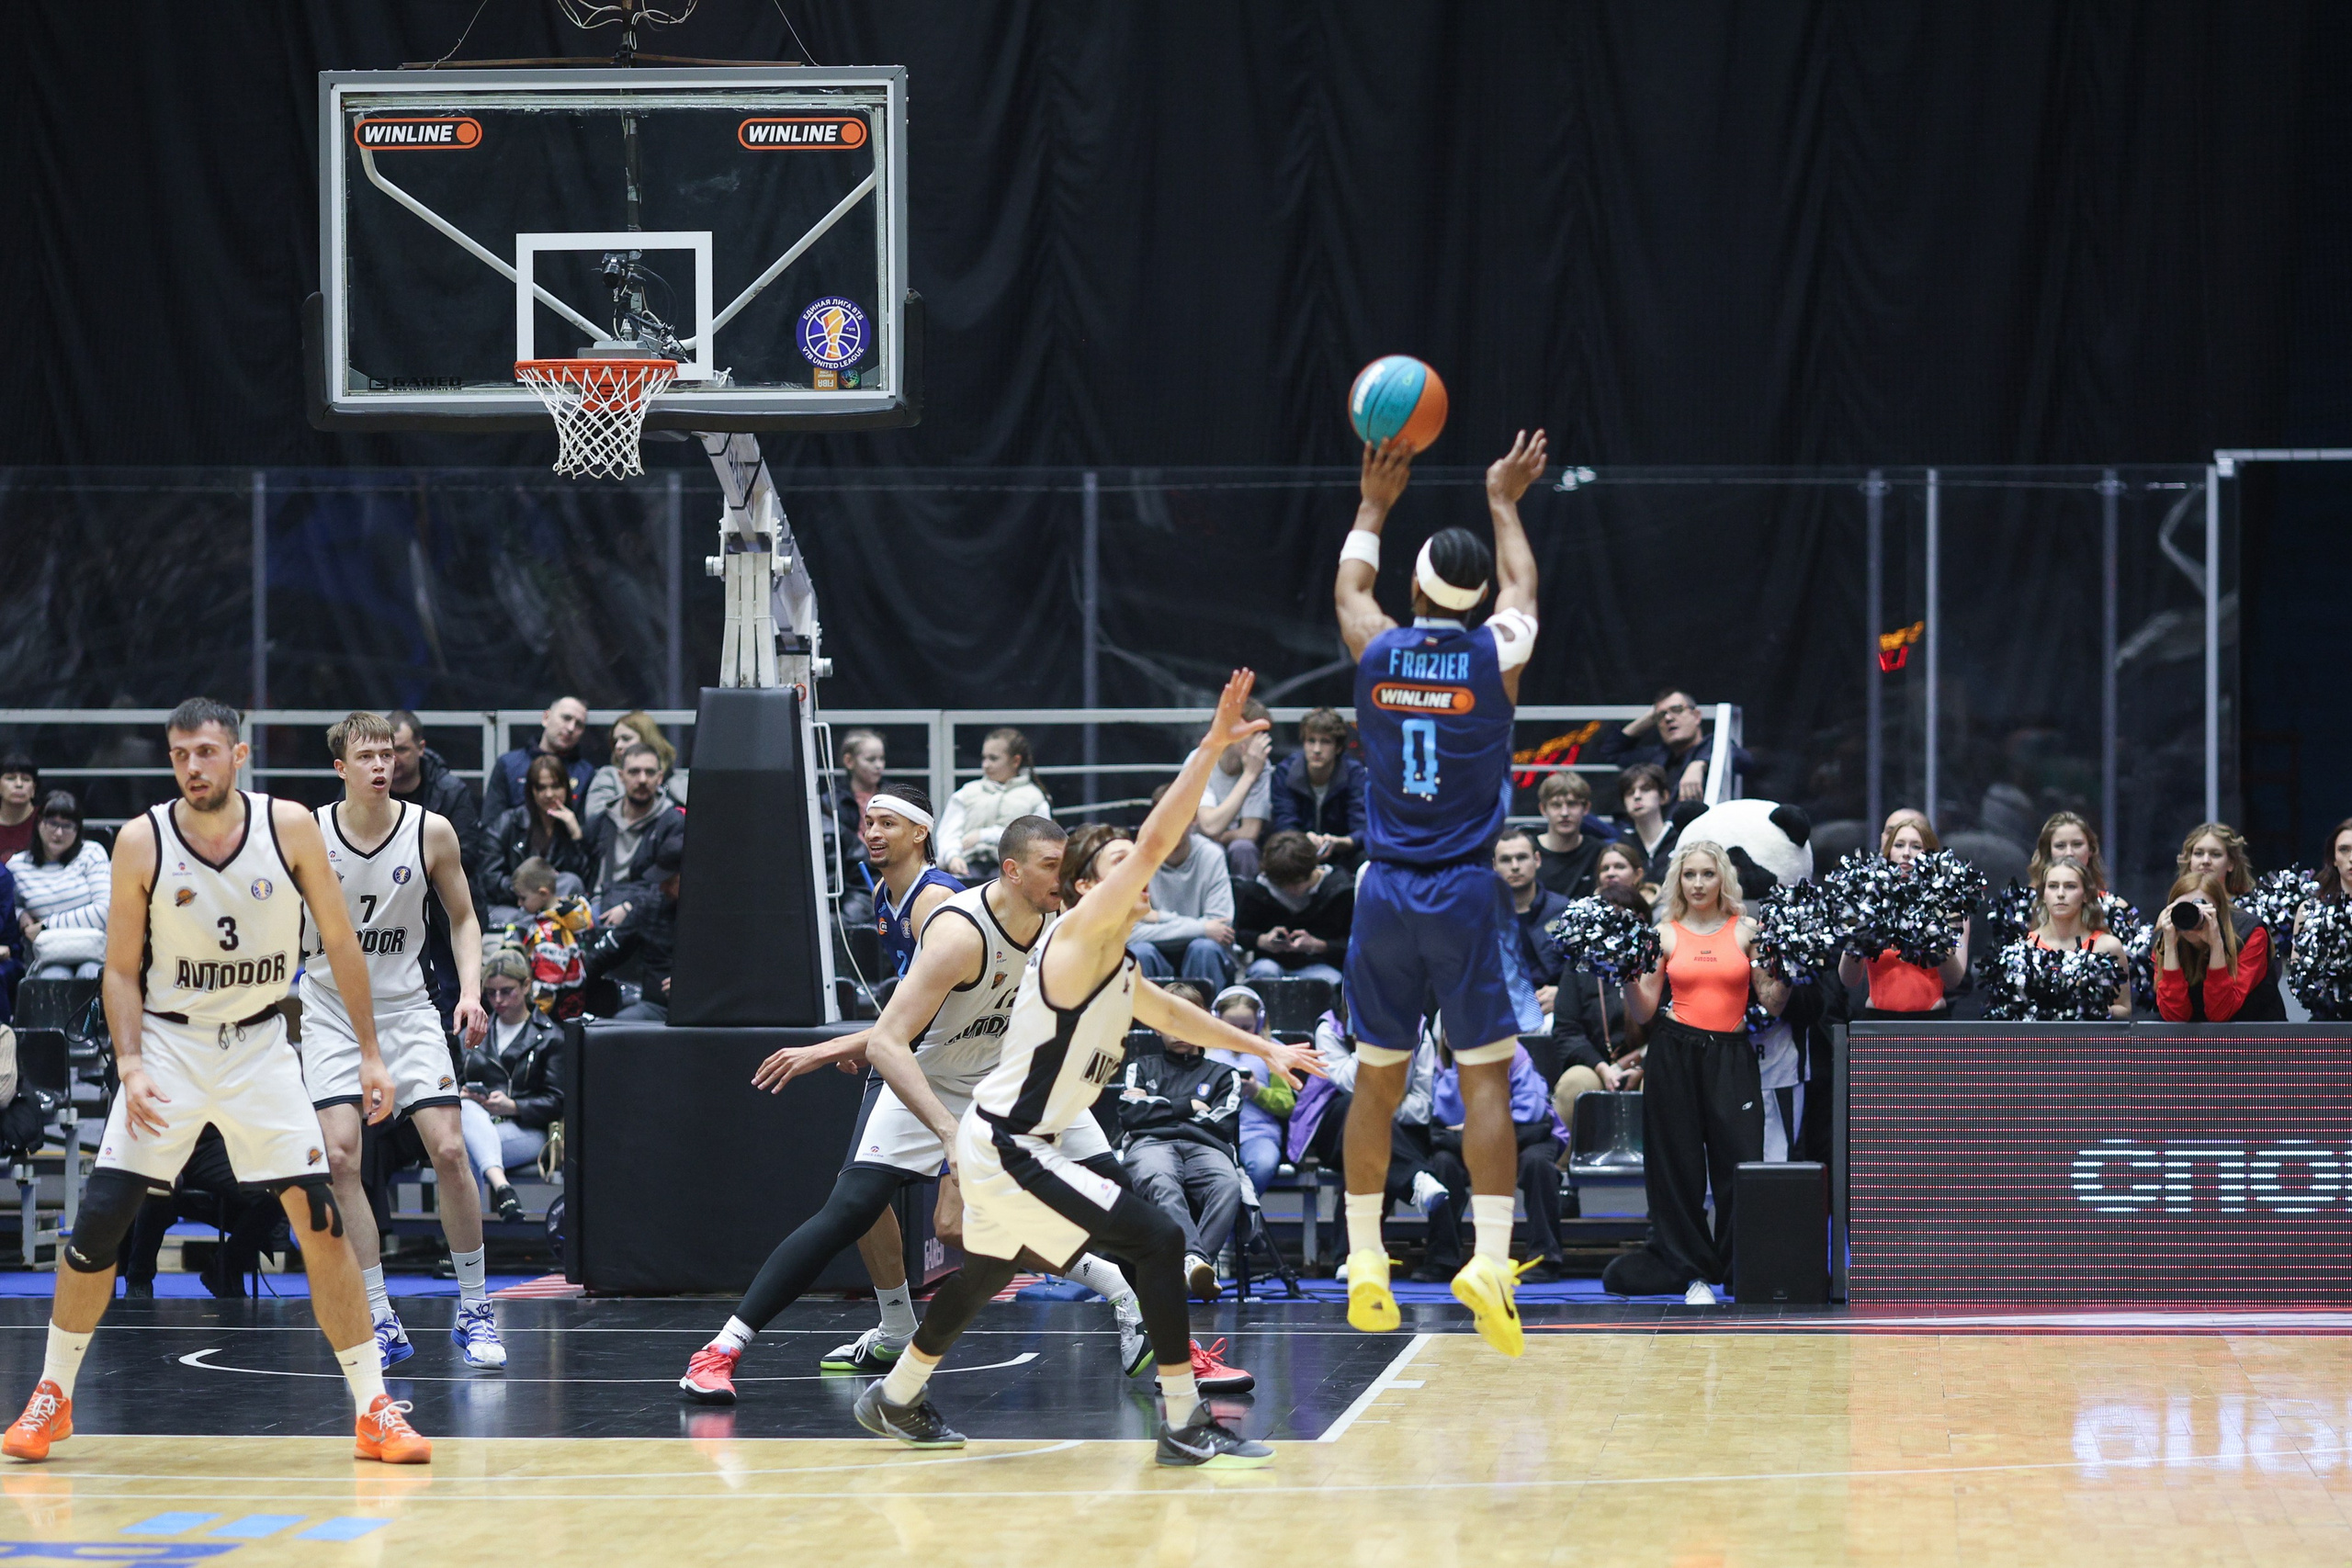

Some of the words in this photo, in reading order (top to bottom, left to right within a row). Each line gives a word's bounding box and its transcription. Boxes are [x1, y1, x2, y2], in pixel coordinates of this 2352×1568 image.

[364, 124, 454, 144] WINLINE
[747, 124, 839, 144] WINLINE
[802, 299, 831, 321] ЕДИНАЯ
[831, 299, 853, 310] ЛИГА
[851, 307, 865, 321] ВТБ
[802, 345, 812, 360] VTB
[812, 358, 839, 369] UNITED
[839, 346, 865, 368] LEAGUE
[392, 376, 462, 387] GARED
[818, 379, 834, 388] FIBA
[1388, 649, 1470, 680] FRAZIER
[1380, 688, 1453, 709] WINLINE
[1401, 718, 1439, 795] 0
[360, 895, 377, 923] 7
[217, 916, 239, 952] 3
[175, 952, 286, 992] AVTODOR
[2069, 1137, 2352, 1214] СПО
